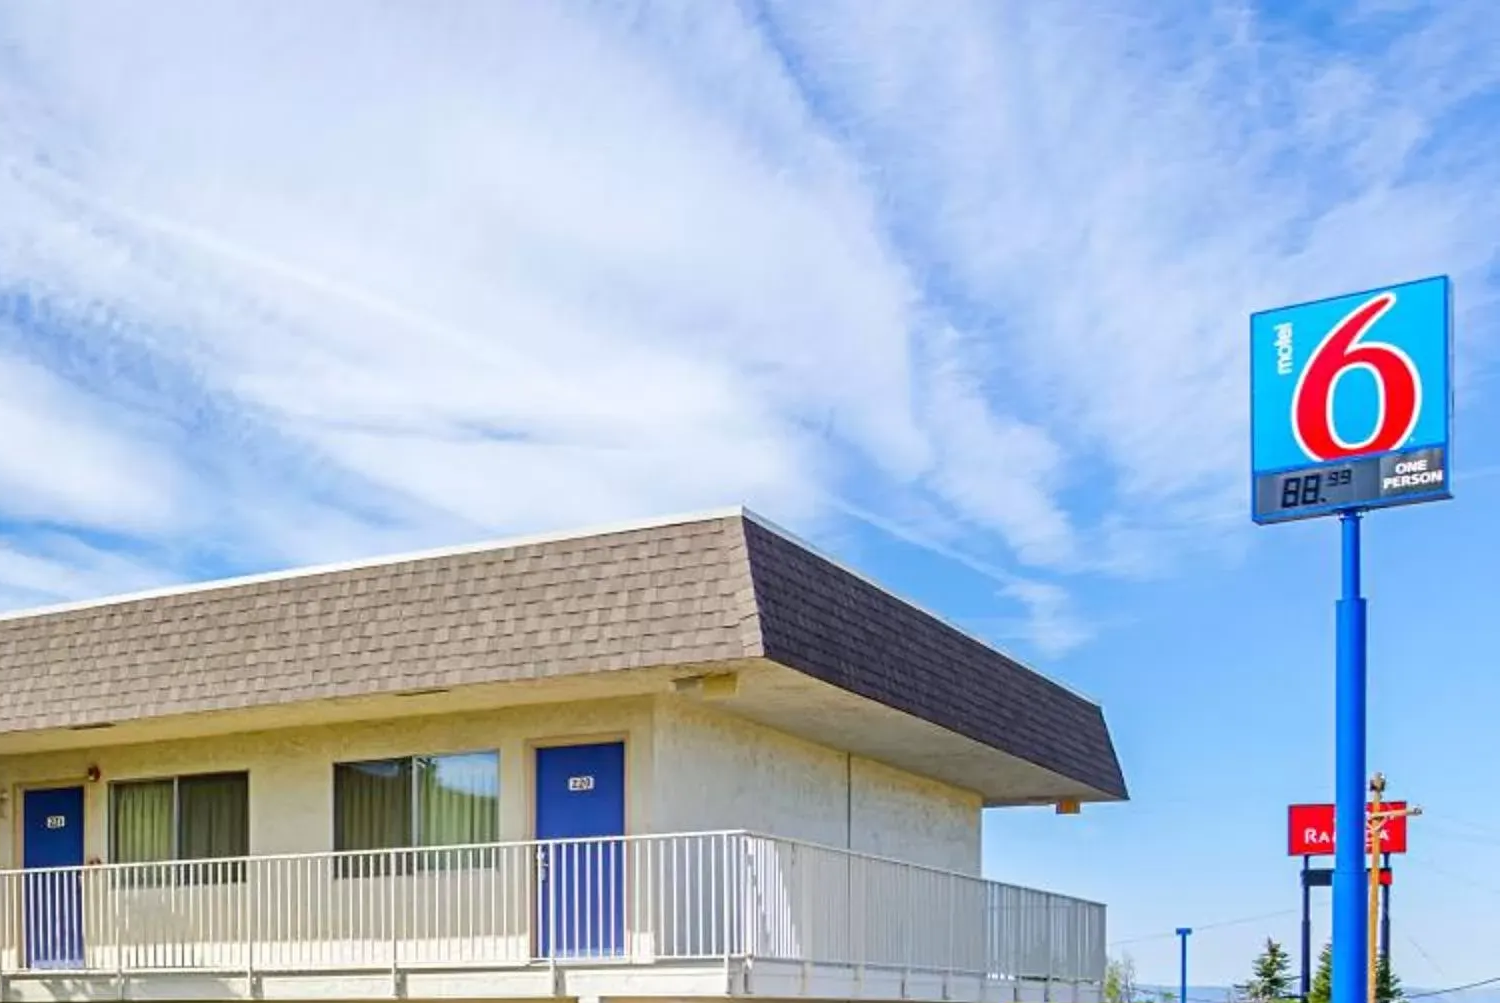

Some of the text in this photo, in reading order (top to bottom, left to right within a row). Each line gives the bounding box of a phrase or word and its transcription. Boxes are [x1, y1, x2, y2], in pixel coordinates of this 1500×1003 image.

[1291, 291, 1422, 462] 6
[1395, 459, 1427, 475] ONE
[1383, 470, 1443, 489] PERSON
